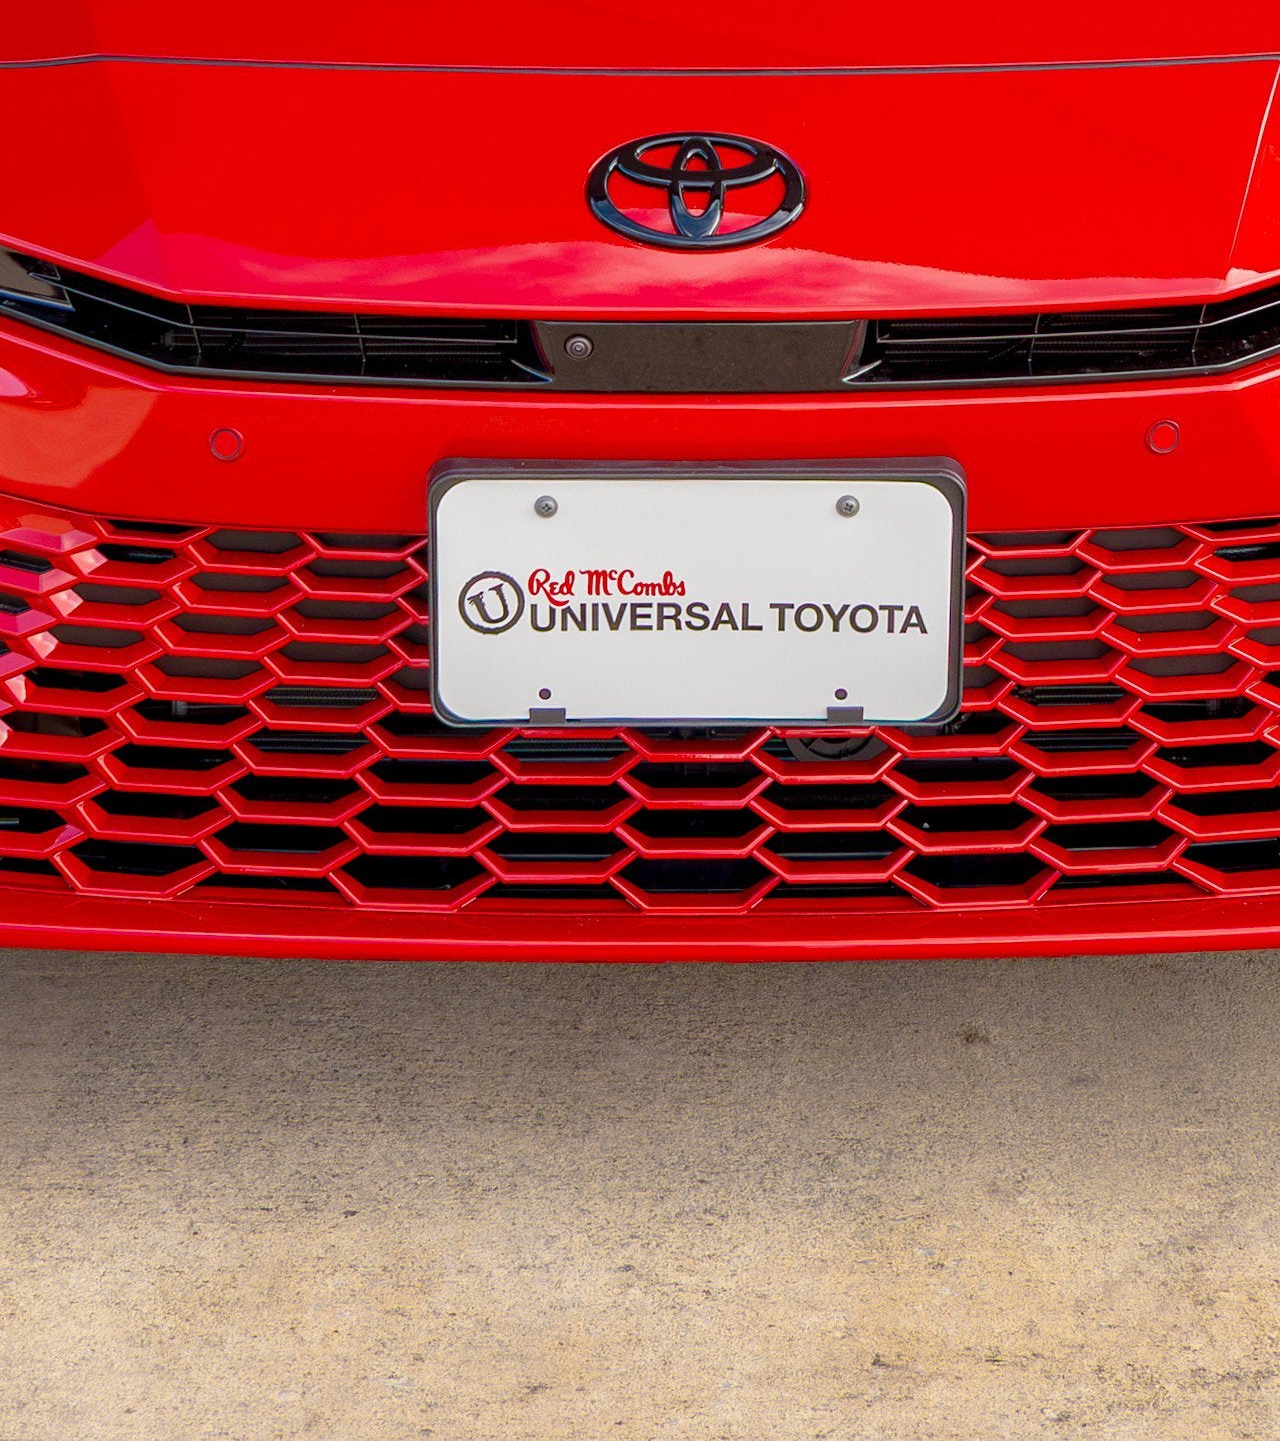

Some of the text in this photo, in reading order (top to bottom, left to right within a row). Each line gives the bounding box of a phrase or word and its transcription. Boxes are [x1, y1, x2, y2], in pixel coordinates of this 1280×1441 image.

[528, 568, 686, 607] Red McCombs
[530, 602, 763, 633] UNIVERSAL
[769, 603, 928, 634] TOYOTA
